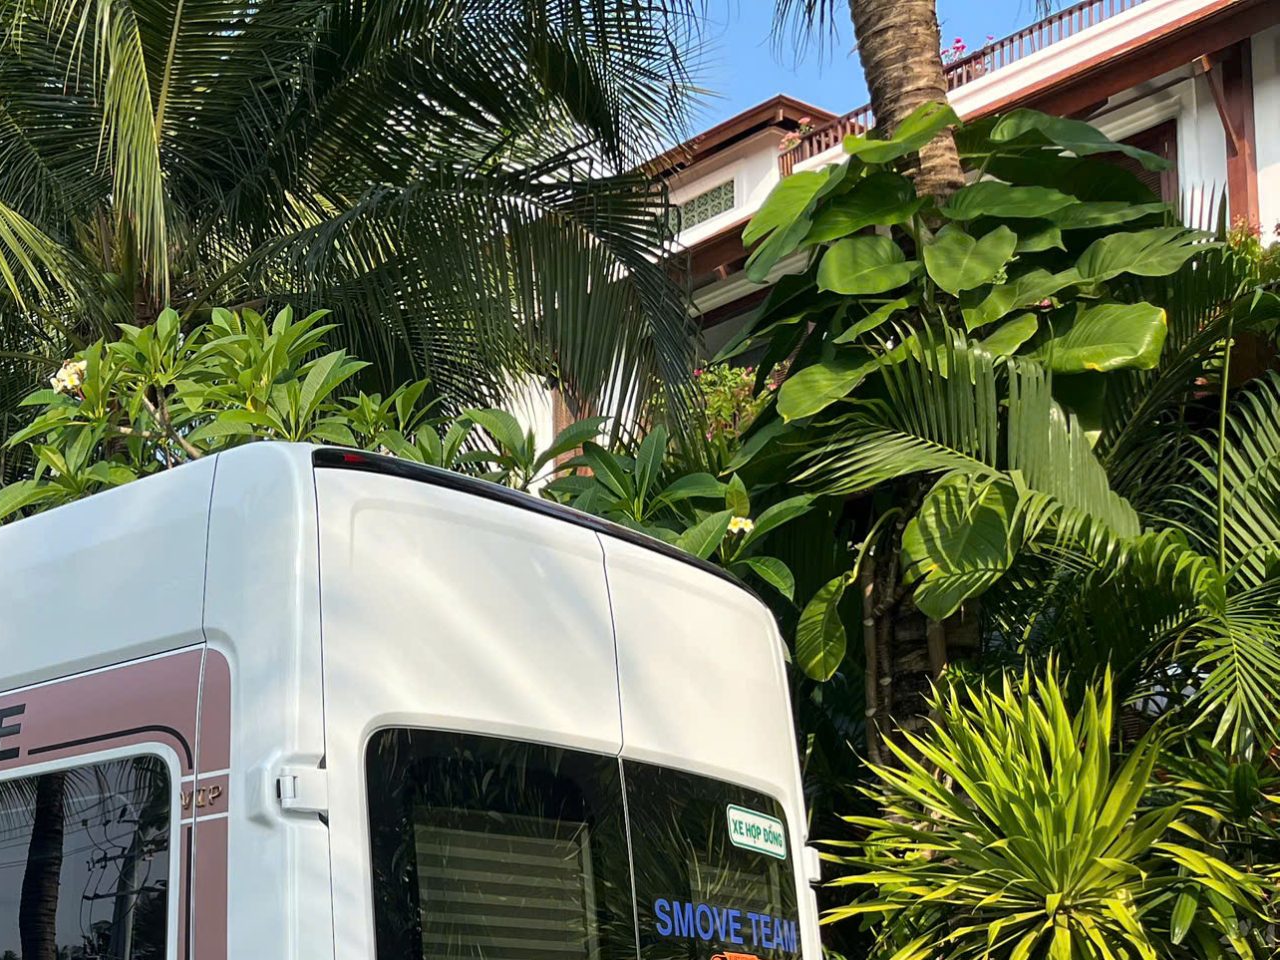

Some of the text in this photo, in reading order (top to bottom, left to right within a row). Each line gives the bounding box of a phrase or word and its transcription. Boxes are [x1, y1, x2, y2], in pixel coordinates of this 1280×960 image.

[180, 785, 222, 811] VIP
[731, 818, 745, 837] XE
[654, 898, 798, 953] SMOVE TEAM
